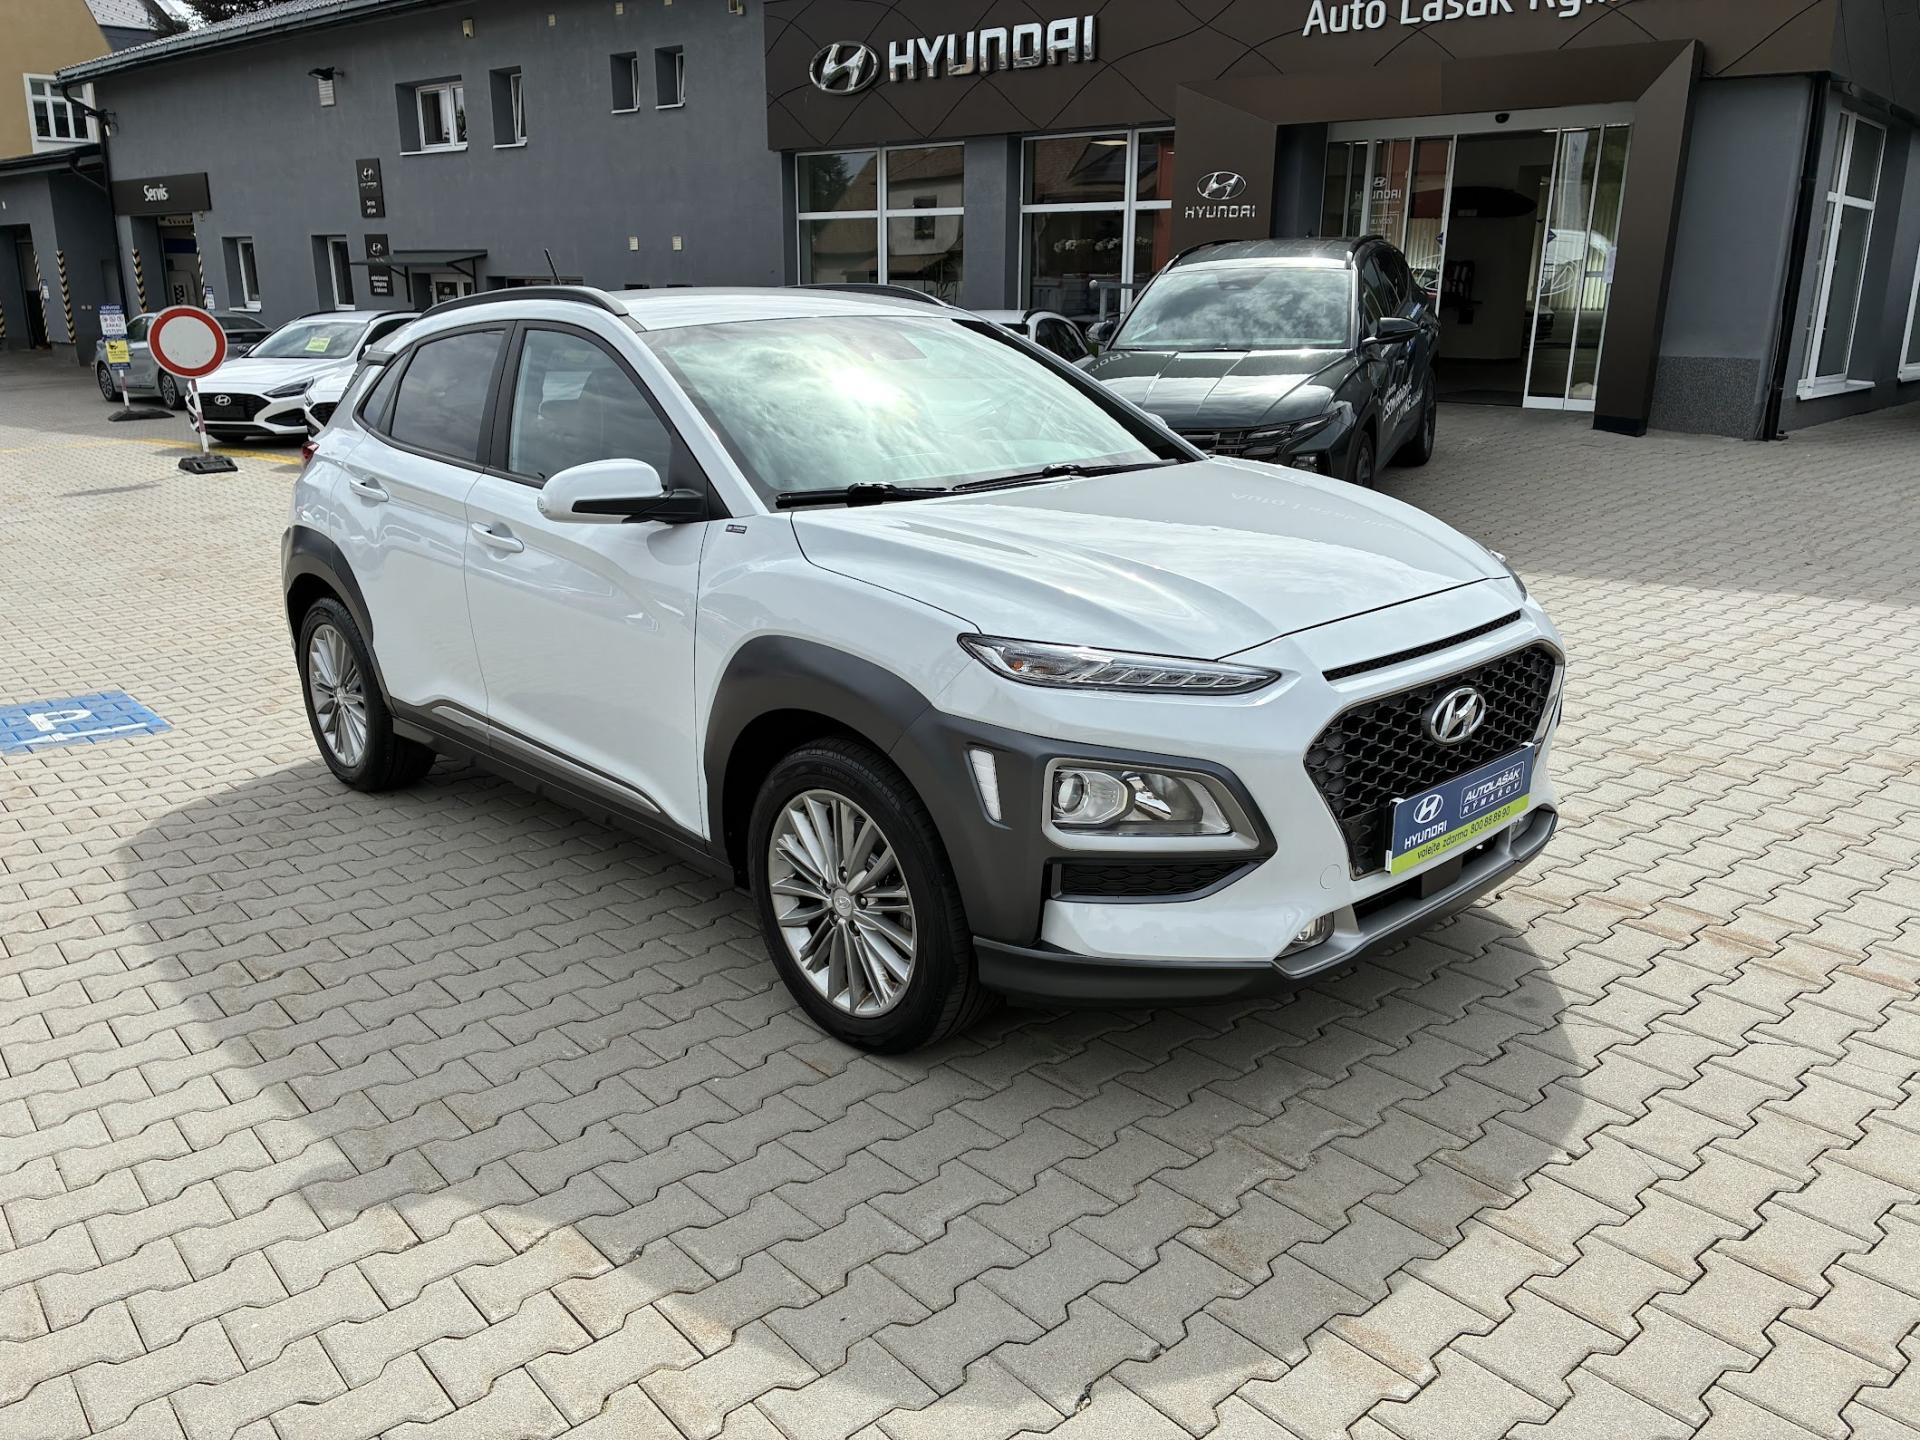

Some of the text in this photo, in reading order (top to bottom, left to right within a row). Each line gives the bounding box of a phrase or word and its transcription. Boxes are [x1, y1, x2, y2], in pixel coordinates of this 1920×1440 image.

[1302, 0, 1387, 36] Auto
[888, 15, 1096, 81] HYUNDAI
[143, 184, 169, 201] Servis
[1355, 189, 1402, 199] HNDAI
[1184, 204, 1256, 219] HYUNDAI
[28, 709, 92, 732] P
[1464, 768, 1520, 803] AUTOLAŠÁK
[1404, 820, 1447, 849] HYUNDAI
[1417, 841, 1441, 859] volejte
[1442, 829, 1468, 847] zdarma
[1470, 819, 1484, 834] 800
